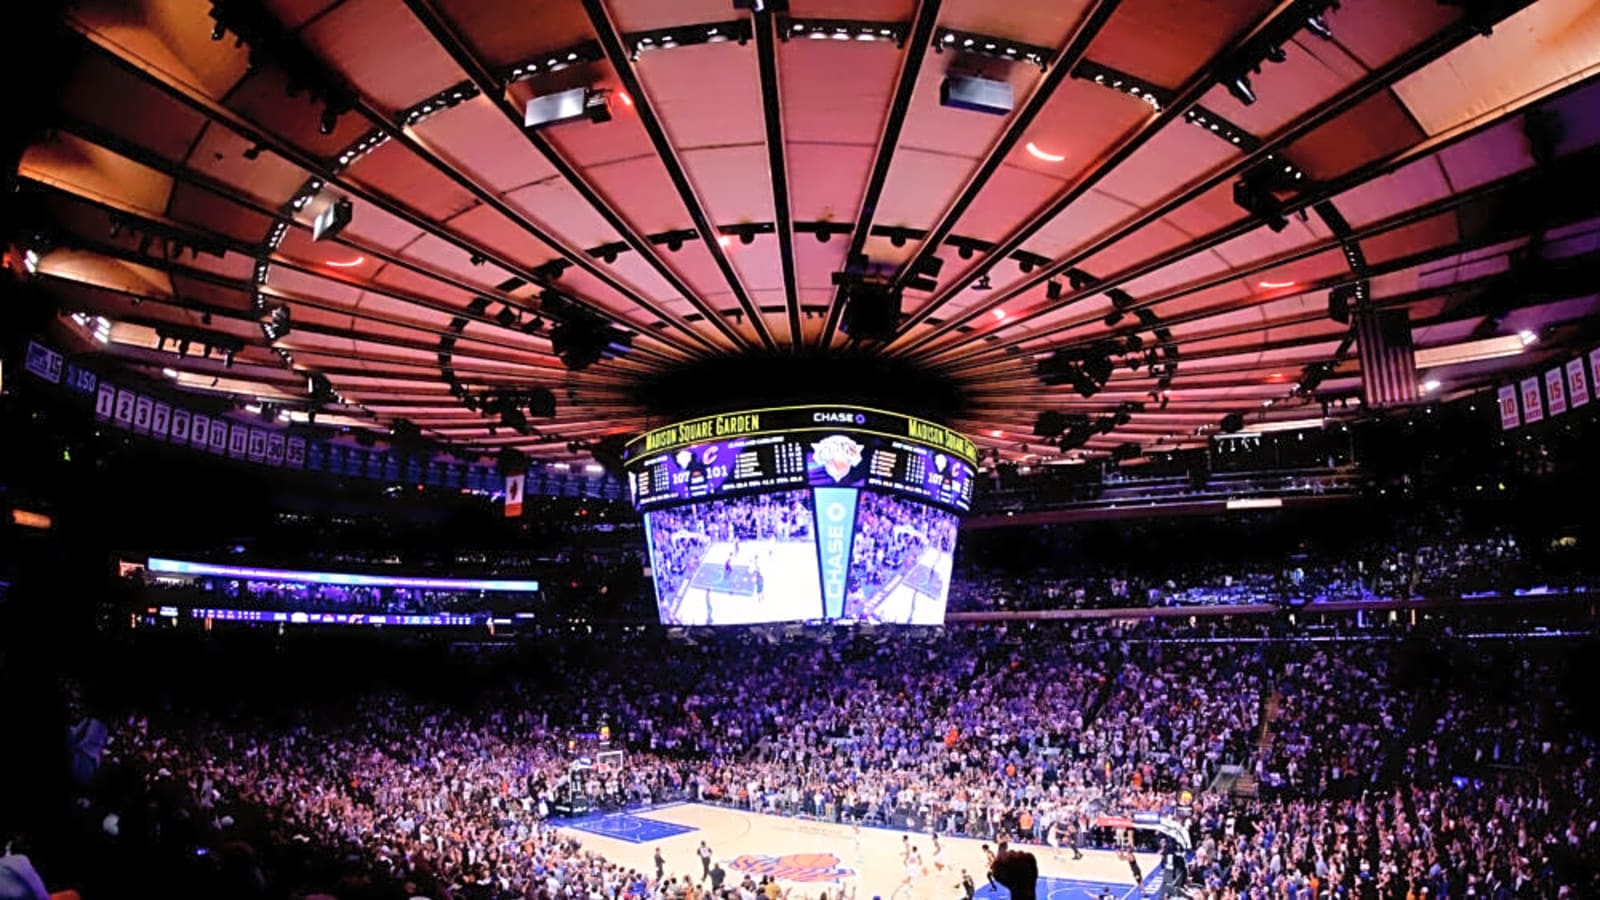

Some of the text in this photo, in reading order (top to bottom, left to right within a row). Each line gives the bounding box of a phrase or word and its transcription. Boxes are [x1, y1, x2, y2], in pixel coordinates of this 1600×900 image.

[77, 369, 97, 392] 150
[1571, 371, 1584, 392] 15
[1526, 390, 1539, 409] 12
[1549, 381, 1562, 401] 15
[101, 395, 108, 413] 1
[120, 401, 129, 419] 2
[1503, 398, 1515, 416] 10
[139, 407, 147, 425] 3
[158, 413, 165, 430] 7
[813, 412, 854, 423] CHASE
[176, 419, 185, 435] 9
[679, 420, 713, 442] SQUARE
[716, 414, 760, 436] GARDEN
[705, 464, 728, 480] 101
[827, 527, 845, 599] CHASE
